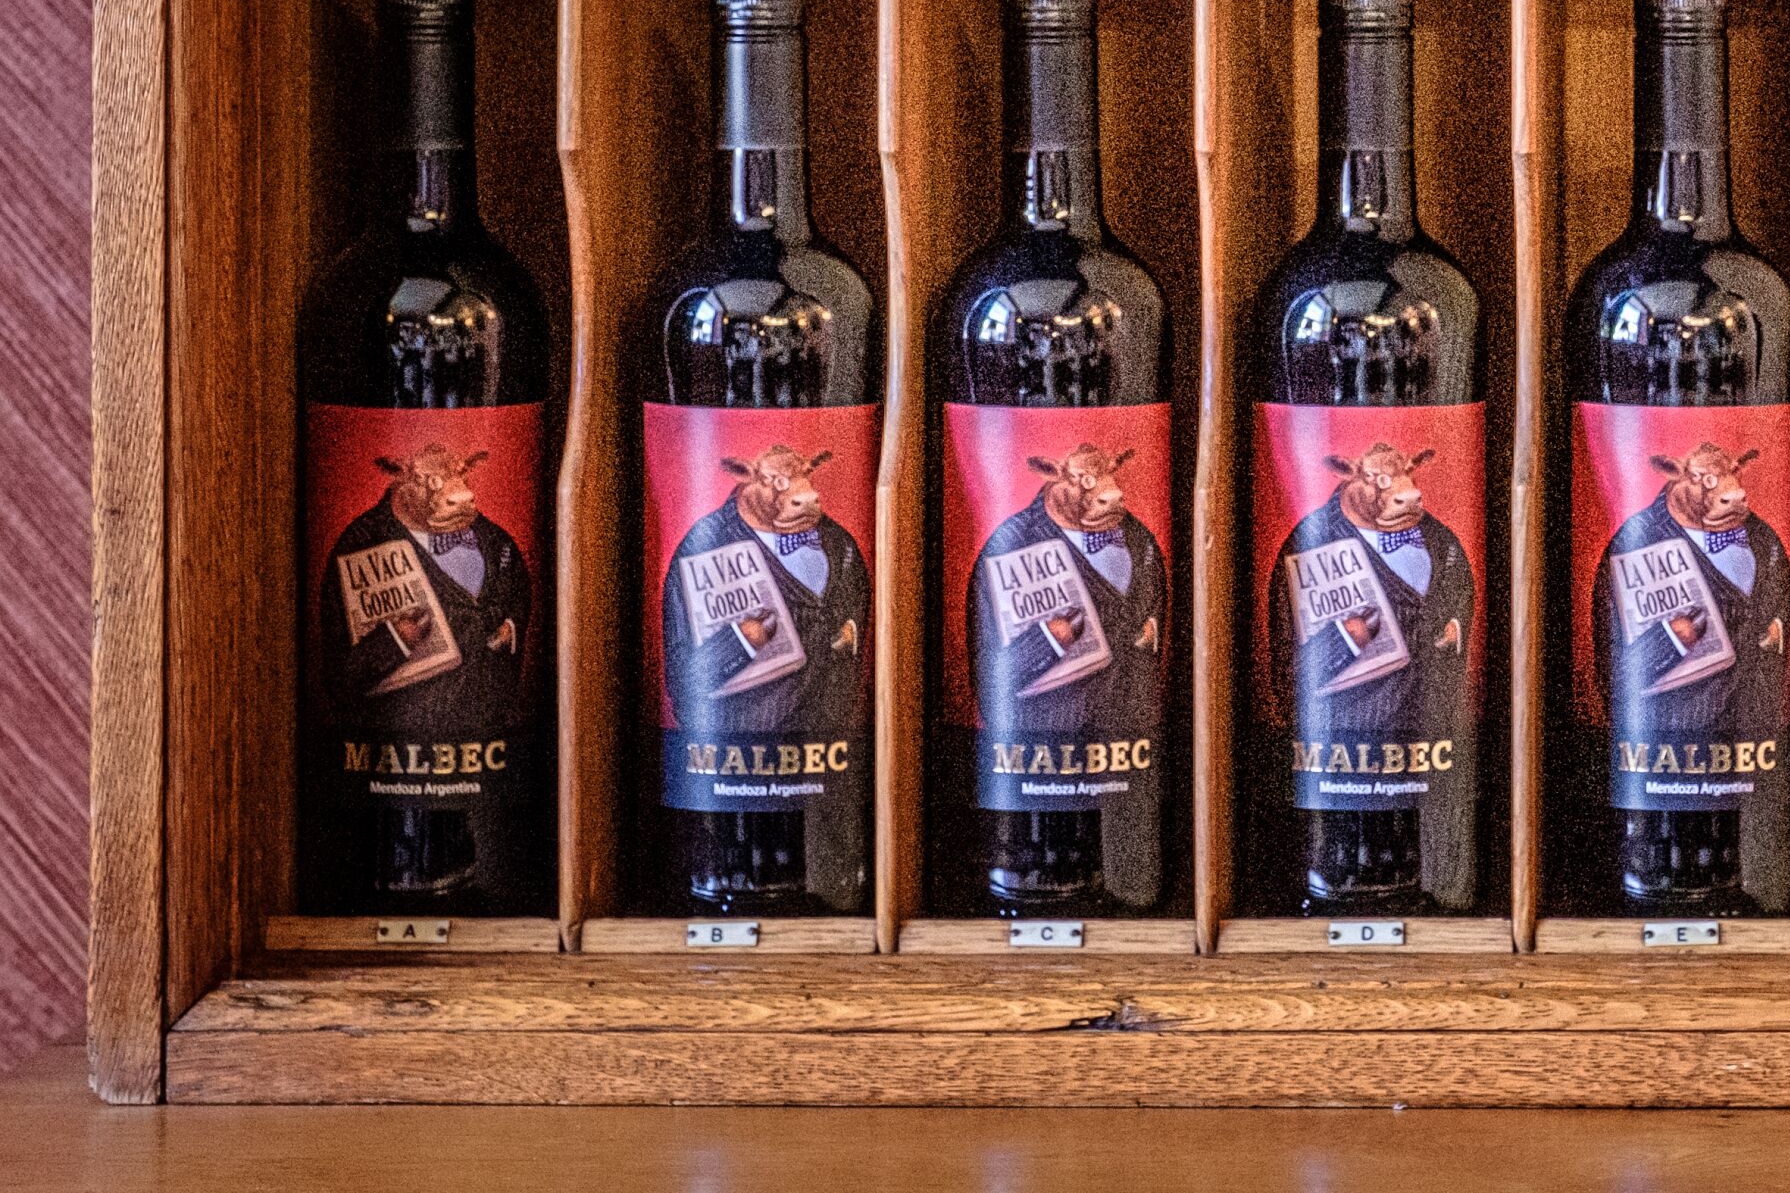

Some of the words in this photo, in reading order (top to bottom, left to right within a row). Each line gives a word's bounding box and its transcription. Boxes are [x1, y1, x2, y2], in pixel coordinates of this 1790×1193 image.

[348, 558, 370, 590] LA
[369, 549, 414, 581] VACA
[690, 559, 714, 591] LA
[713, 550, 759, 581] VACA
[995, 557, 1020, 590] LA
[1019, 549, 1067, 580] VACA
[1295, 556, 1318, 589] LA
[1315, 548, 1363, 580] VACA
[1620, 556, 1643, 589] LA
[1642, 548, 1689, 579] VACA
[360, 589, 415, 618] GORDA
[705, 590, 761, 619] GORDA
[1012, 588, 1069, 619] GORDA
[1309, 588, 1365, 618] GORDA
[1635, 588, 1692, 618] GORDA
[344, 740, 506, 774] MALBEC
[686, 741, 848, 775] MALBEC
[992, 740, 1151, 774] MALBEC
[1292, 740, 1453, 774] MALBEC
[1619, 740, 1776, 774] MALBEC
[370, 781, 421, 795] Mendoza
[423, 781, 480, 796] Argentina
[714, 782, 767, 796] Mendoza
[768, 781, 824, 797] Argentina
[1022, 781, 1075, 795] Mendoza
[1077, 781, 1128, 796] Argentina
[1320, 781, 1373, 794] Mendoza
[1374, 781, 1428, 796] Argentina
[1646, 781, 1699, 794] Mendoza
[1700, 781, 1754, 796] Argentina
[403, 924, 416, 938] A
[712, 928, 723, 942] B
[1041, 927, 1054, 940] C
[1361, 927, 1373, 940] D
[1677, 928, 1688, 941] E
